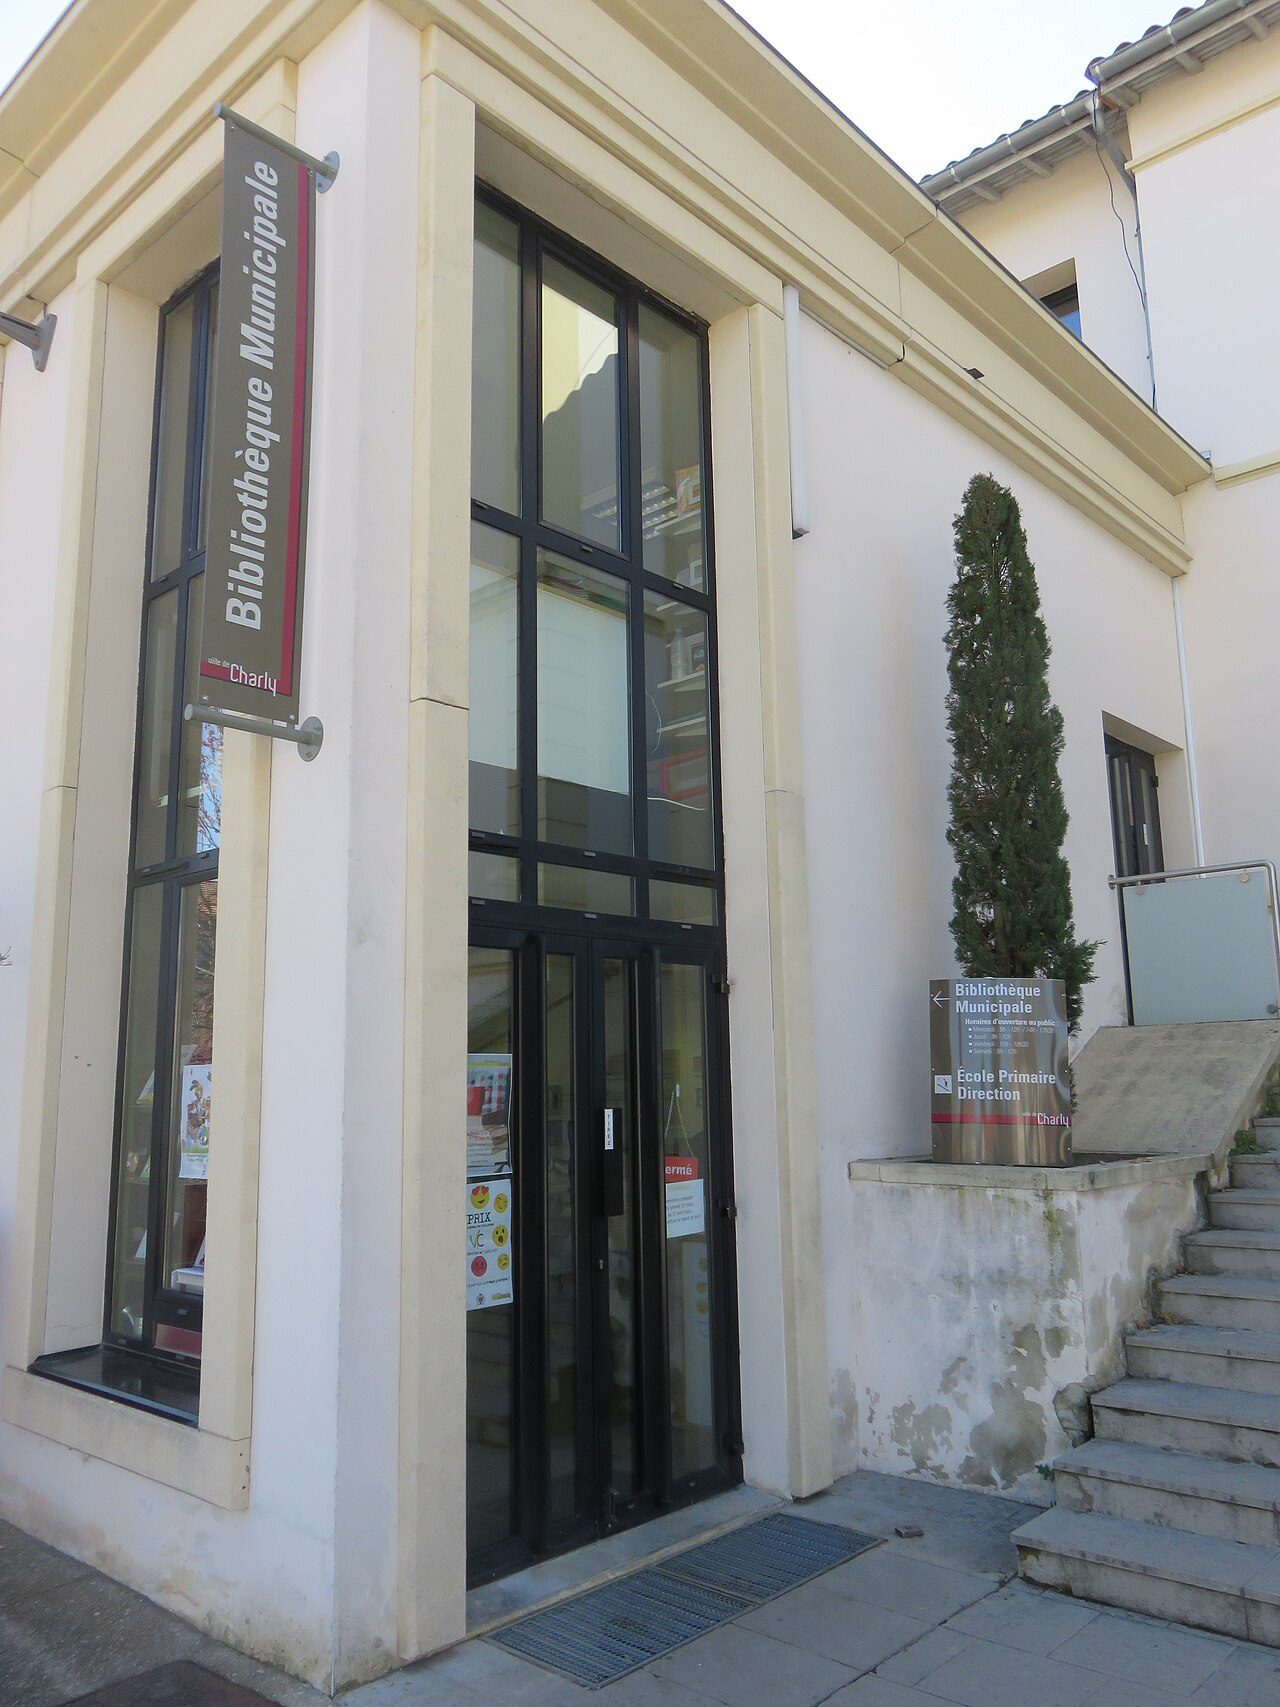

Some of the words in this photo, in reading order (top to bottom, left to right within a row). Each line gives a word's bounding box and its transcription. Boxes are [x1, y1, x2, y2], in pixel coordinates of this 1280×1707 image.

[239, 160, 287, 371] Municipale
[225, 376, 281, 631] Bibliothèque
[221, 660, 230, 669] de
[230, 663, 277, 697] Charly
[955, 983, 1041, 999] Bibliothèque
[955, 1000, 1033, 1016] Municipale
[992, 1018, 1028, 1026] d'ouverture
[1037, 1019, 1056, 1027] public
[957, 1066, 995, 1083] École
[998, 1069, 1056, 1084] Primaire
[957, 1086, 1021, 1100] Direction
[1037, 1112, 1069, 1128] Charly
[664, 1163, 693, 1176] ermé
[466, 1211, 492, 1225] PRIX
